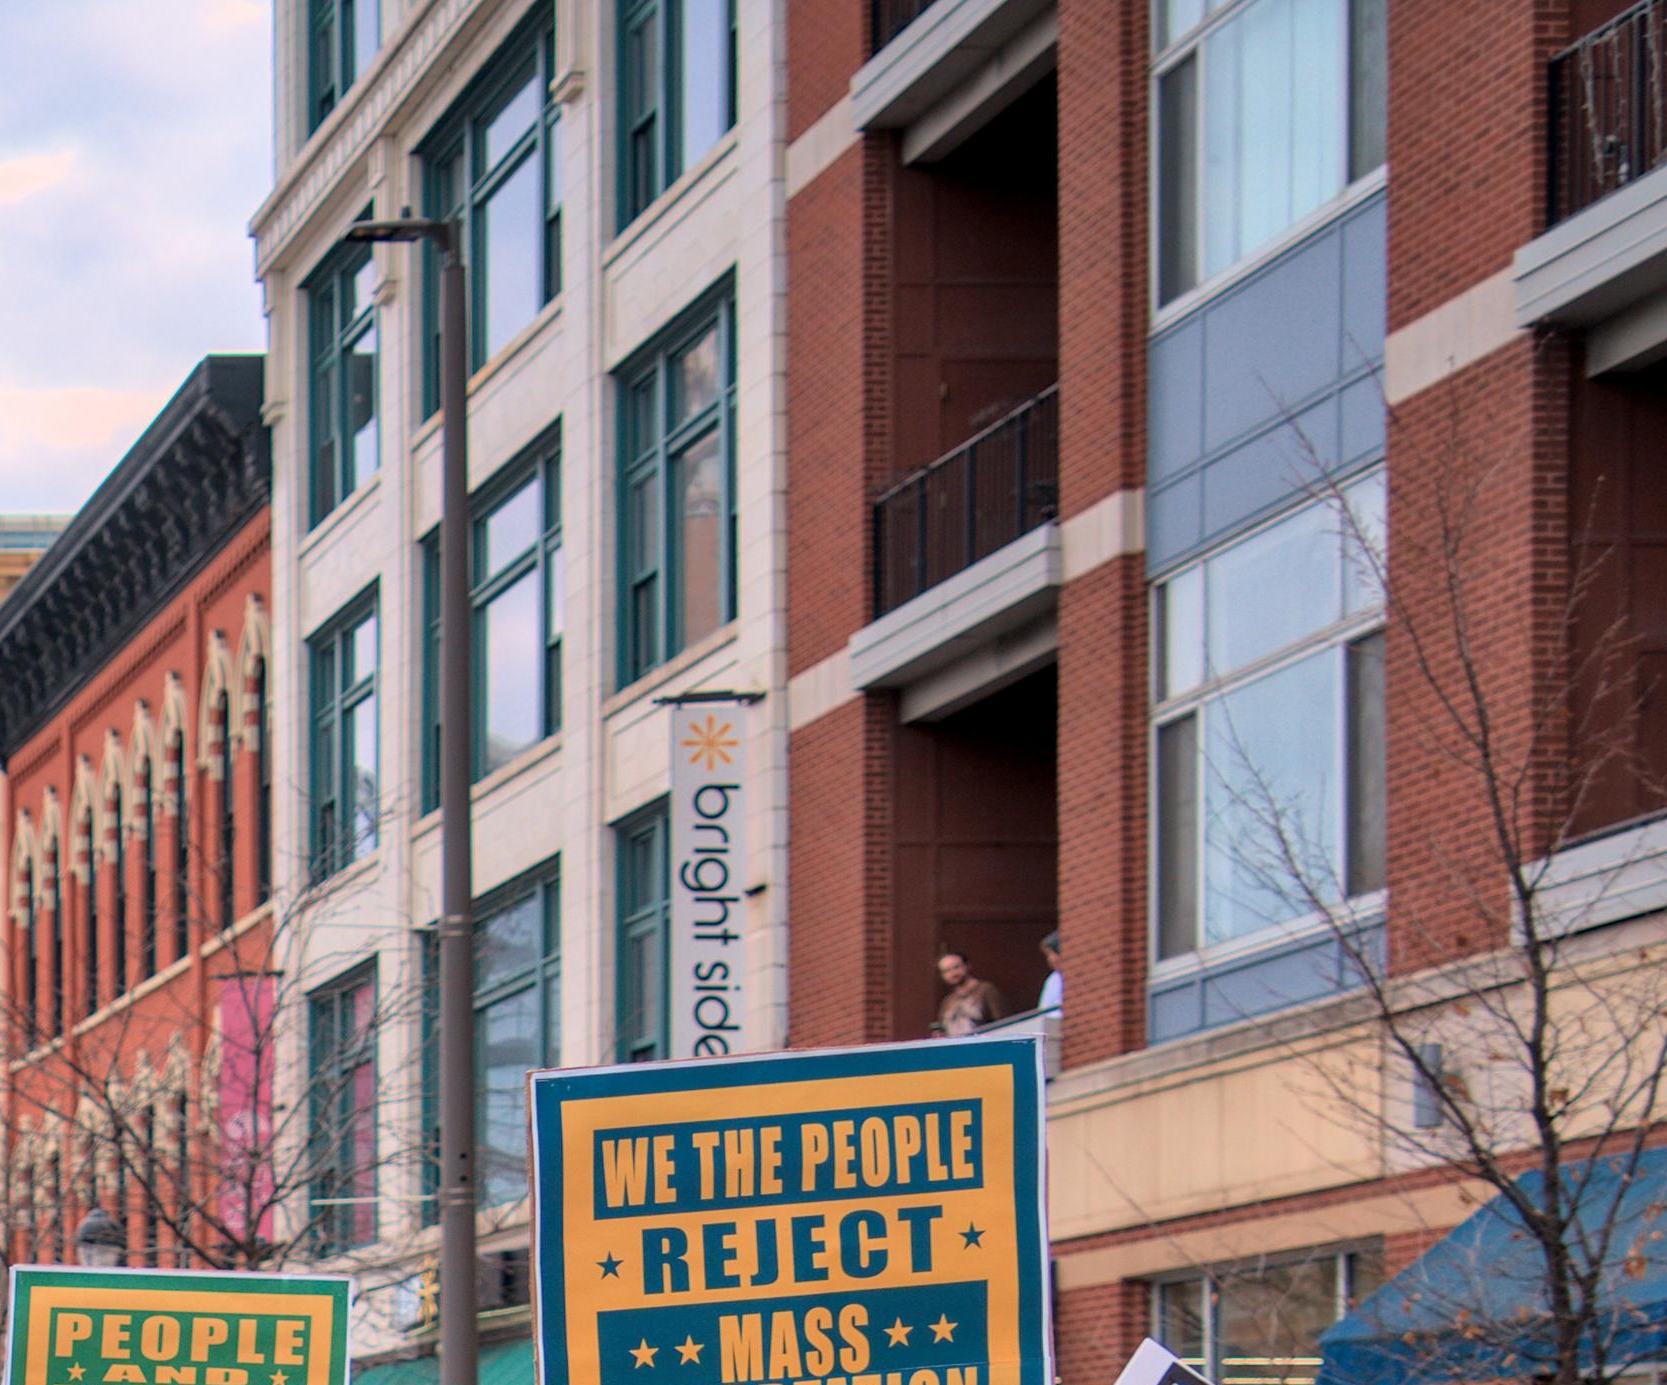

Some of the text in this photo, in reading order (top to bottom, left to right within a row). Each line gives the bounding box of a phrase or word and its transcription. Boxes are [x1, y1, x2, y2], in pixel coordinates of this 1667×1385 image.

[679, 783, 741, 1057] bright side
[601, 1110, 975, 1208] WE THE PEOPLE
[641, 1205, 943, 1295] REJECT
[55, 1312, 306, 1366] PEOPLE
[719, 1304, 870, 1383] MASS
